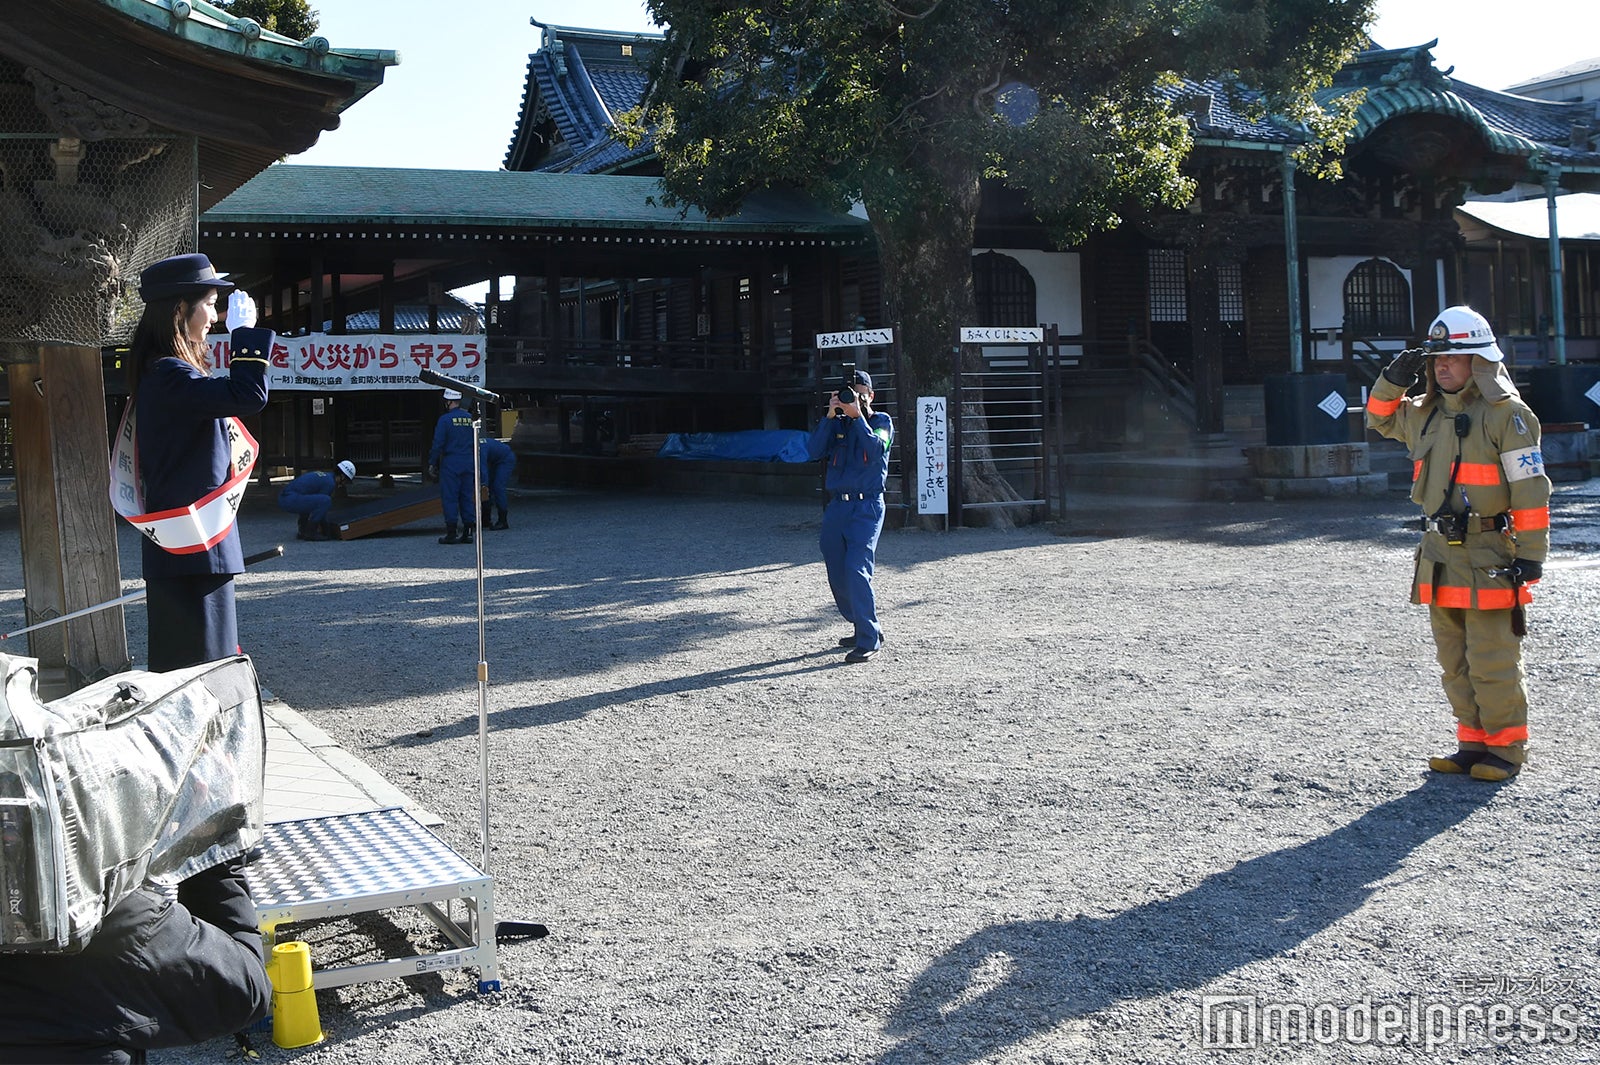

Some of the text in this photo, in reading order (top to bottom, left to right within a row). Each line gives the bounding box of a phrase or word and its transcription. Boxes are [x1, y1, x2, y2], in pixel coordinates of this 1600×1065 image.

[821, 332, 889, 346] おみくじはここへ
[966, 330, 1038, 341] おみくじはここへ
[300, 343, 399, 370] 火災から
[410, 342, 481, 369] 守ろう
